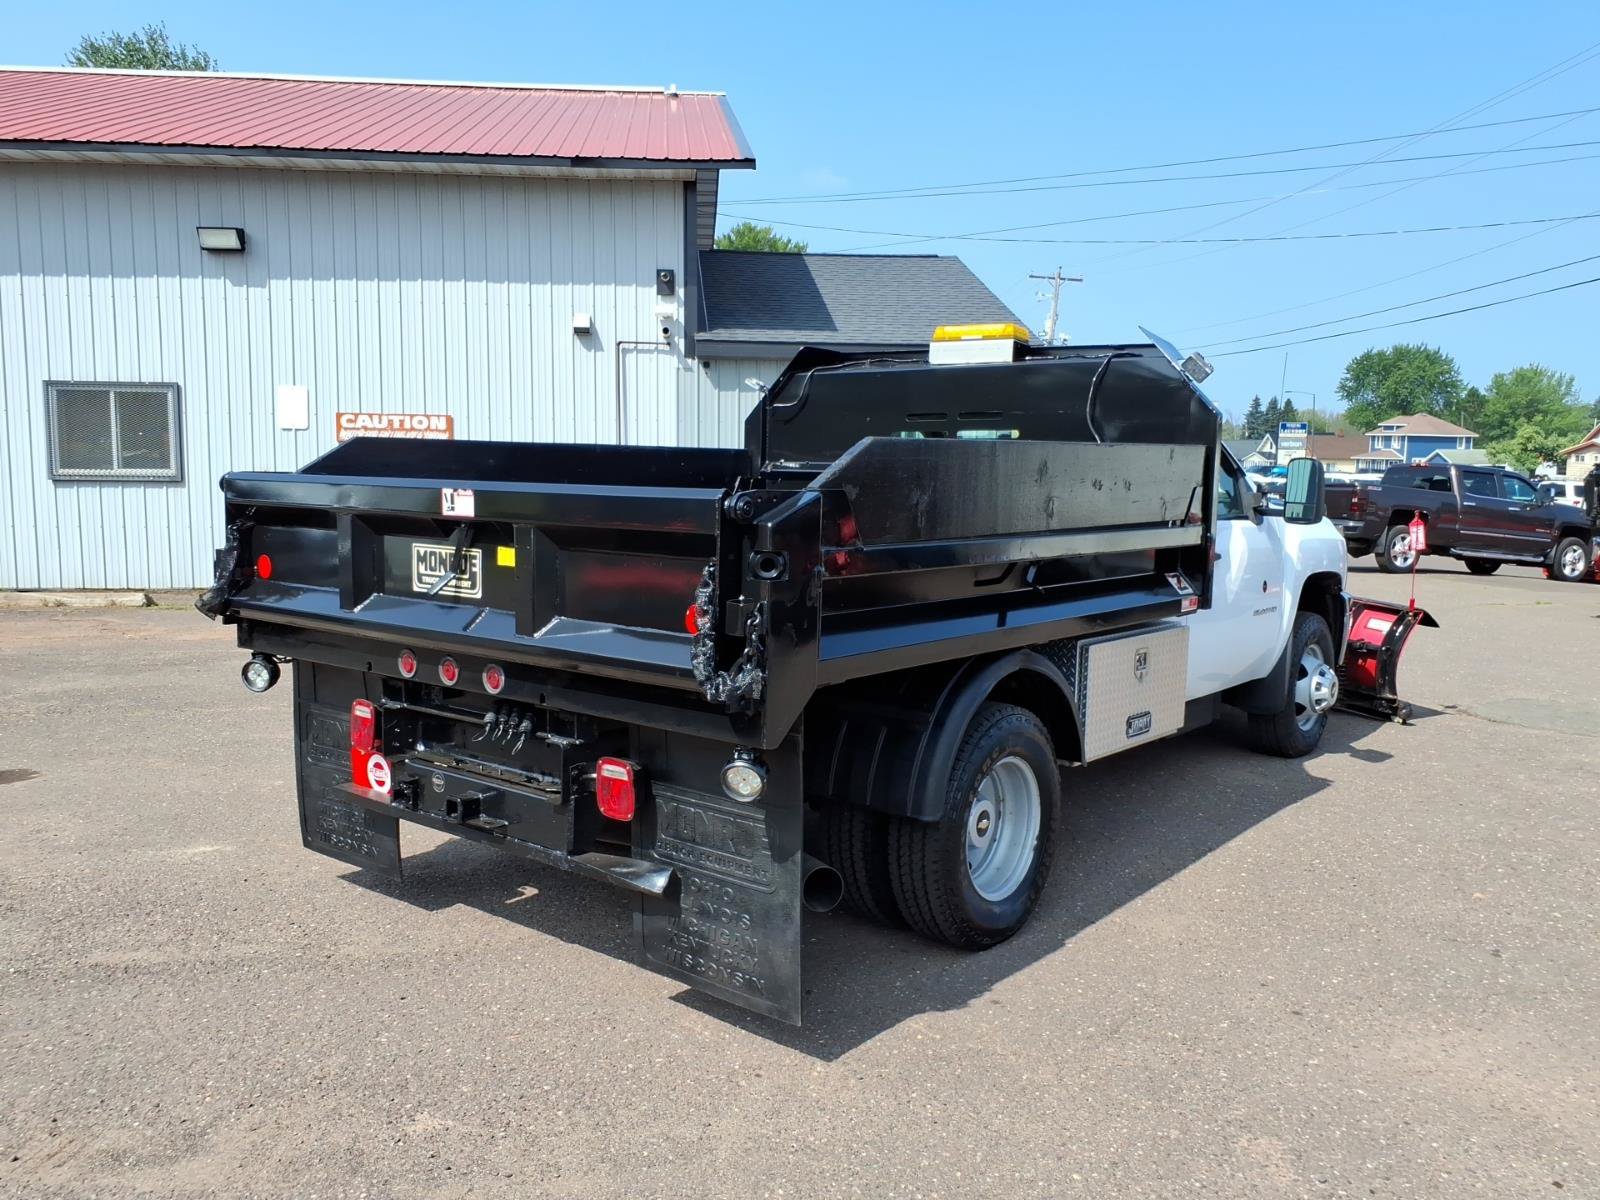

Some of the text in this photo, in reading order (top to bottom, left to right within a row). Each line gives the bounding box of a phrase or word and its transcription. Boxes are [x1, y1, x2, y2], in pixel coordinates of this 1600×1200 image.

[340, 413, 447, 430] CAUTION
[416, 549, 478, 580] MONOE
[687, 876, 735, 902] OHIO
[661, 944, 765, 996] WISCONSIN
